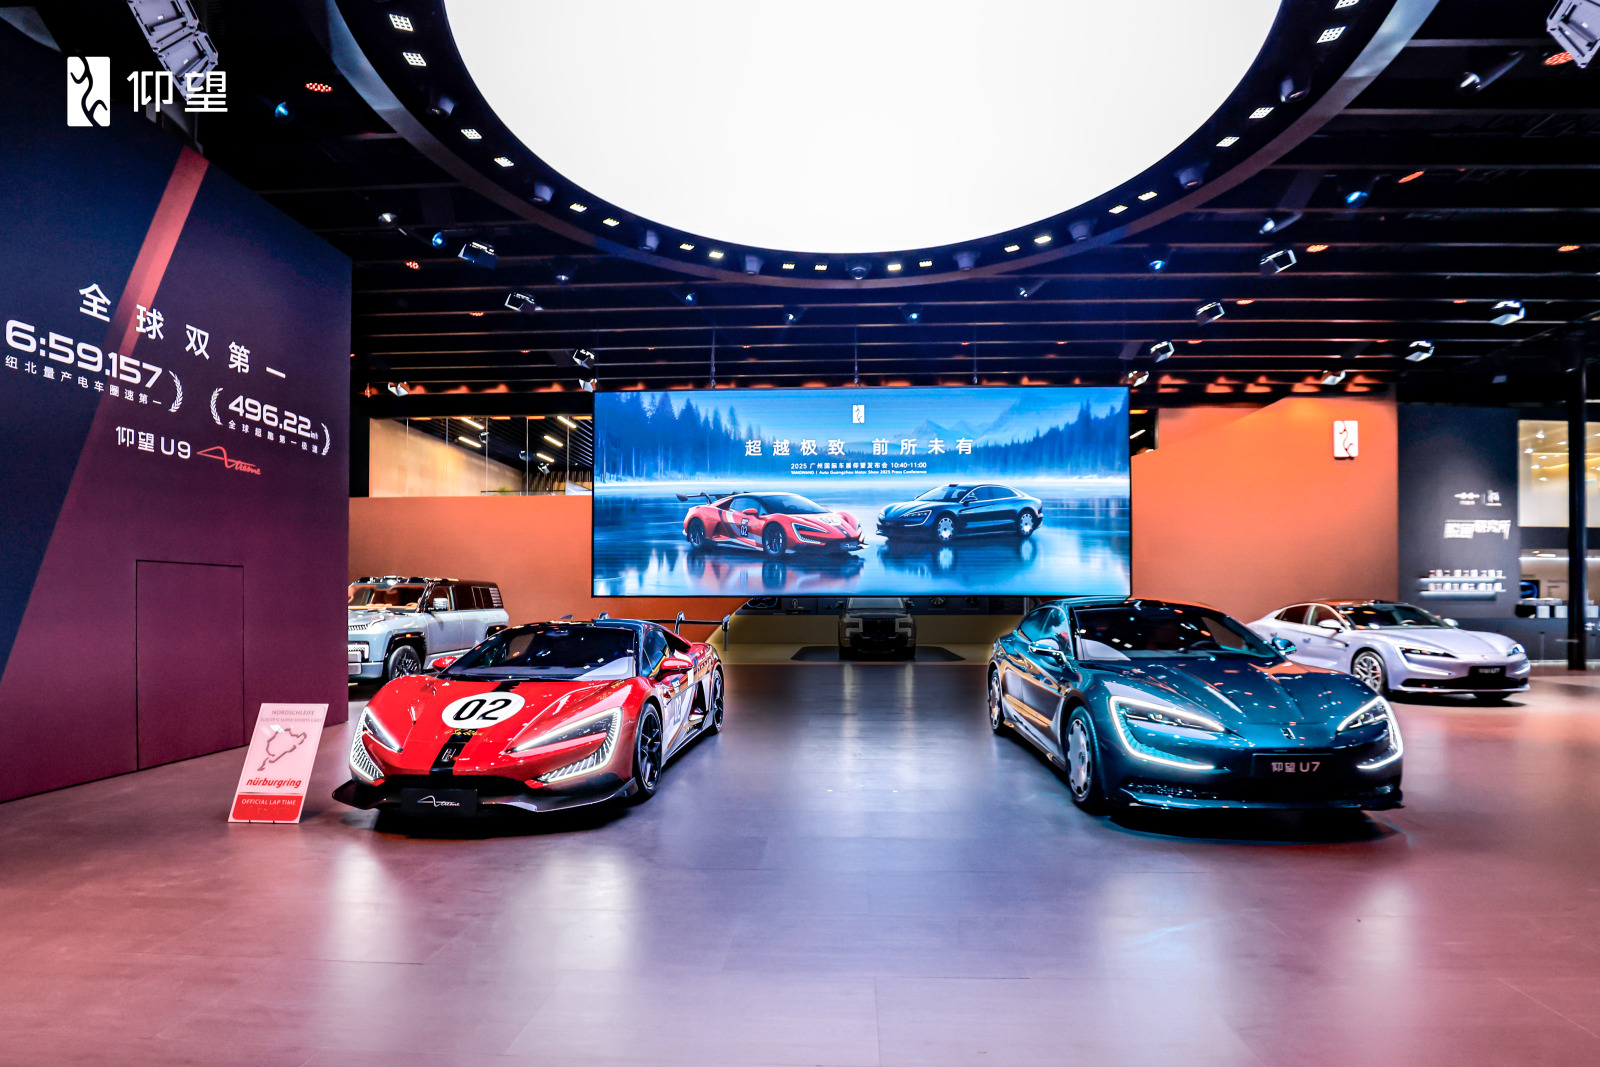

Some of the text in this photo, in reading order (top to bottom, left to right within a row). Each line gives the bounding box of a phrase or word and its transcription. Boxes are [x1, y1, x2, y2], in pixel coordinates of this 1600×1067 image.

[78, 283, 286, 378] 全球双第一
[5, 319, 162, 388] 6:59.157
[5, 355, 163, 405] 纽北量产电车圈速第一
[115, 425, 191, 459] 仰望 U9
[745, 438, 974, 457] 超越极致 前所未有
[452, 698, 512, 721] 02
[1299, 761, 1321, 773] U7
[246, 777, 302, 789] nürburgring
